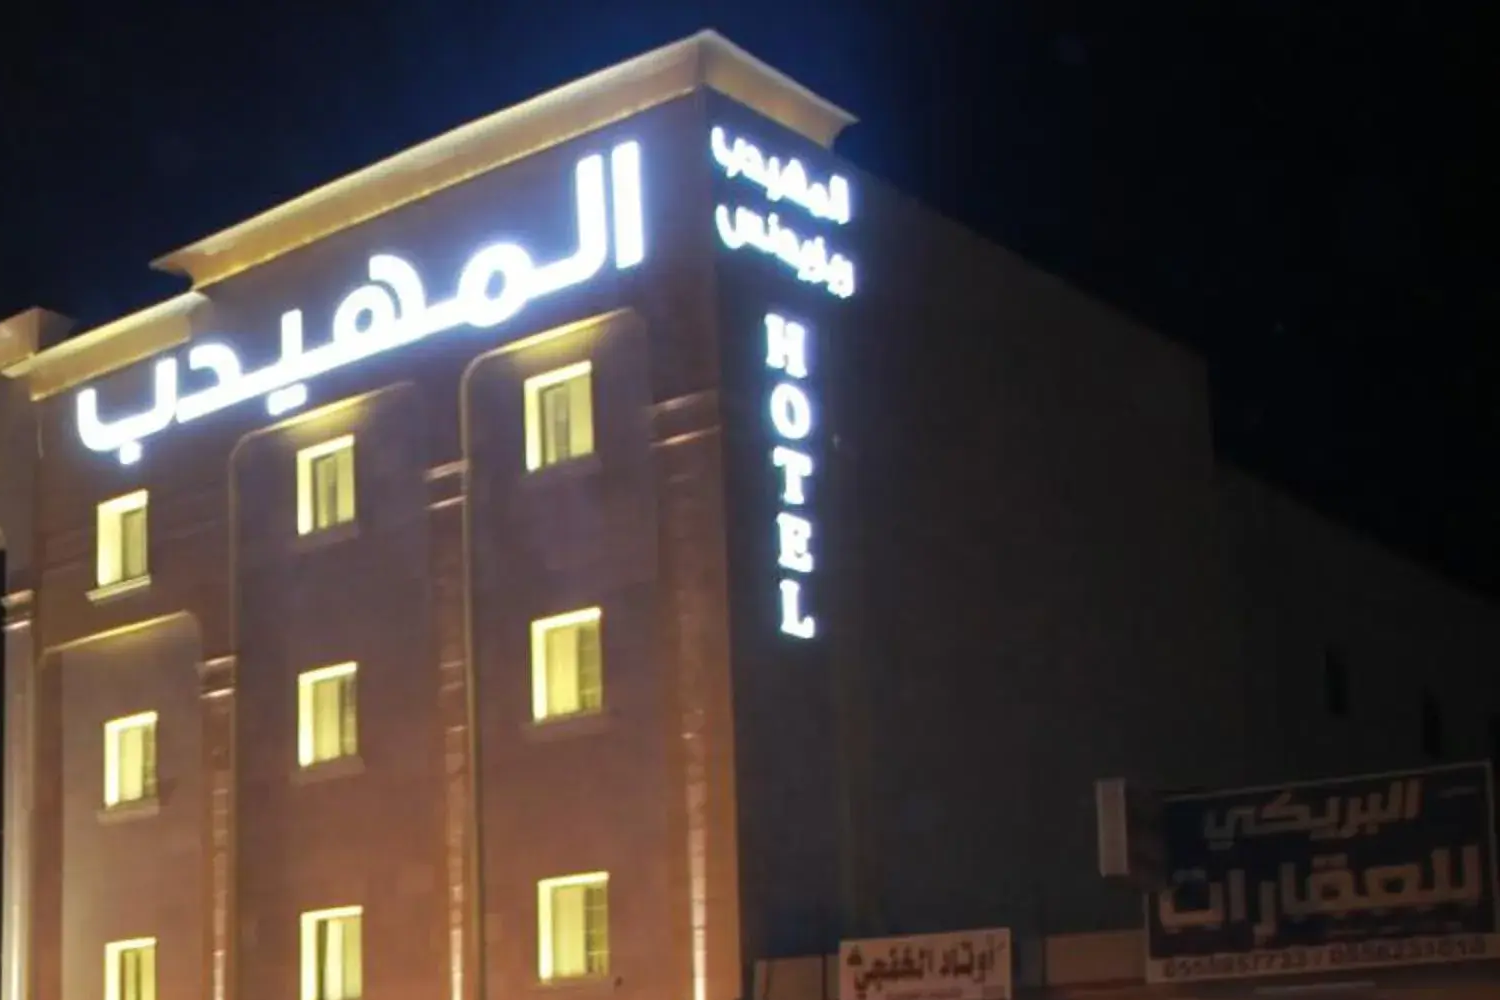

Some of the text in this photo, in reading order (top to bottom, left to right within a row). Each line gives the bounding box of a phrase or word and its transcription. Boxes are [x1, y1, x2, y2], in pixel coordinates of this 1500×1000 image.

[711, 127, 850, 224] المهيدب
[716, 205, 855, 298] ريزيدنس
[77, 141, 645, 465] المهيدب
[765, 313, 814, 639] HOTEL
[1203, 778, 1424, 851] البريكي
[1157, 842, 1484, 946] للعقارات
